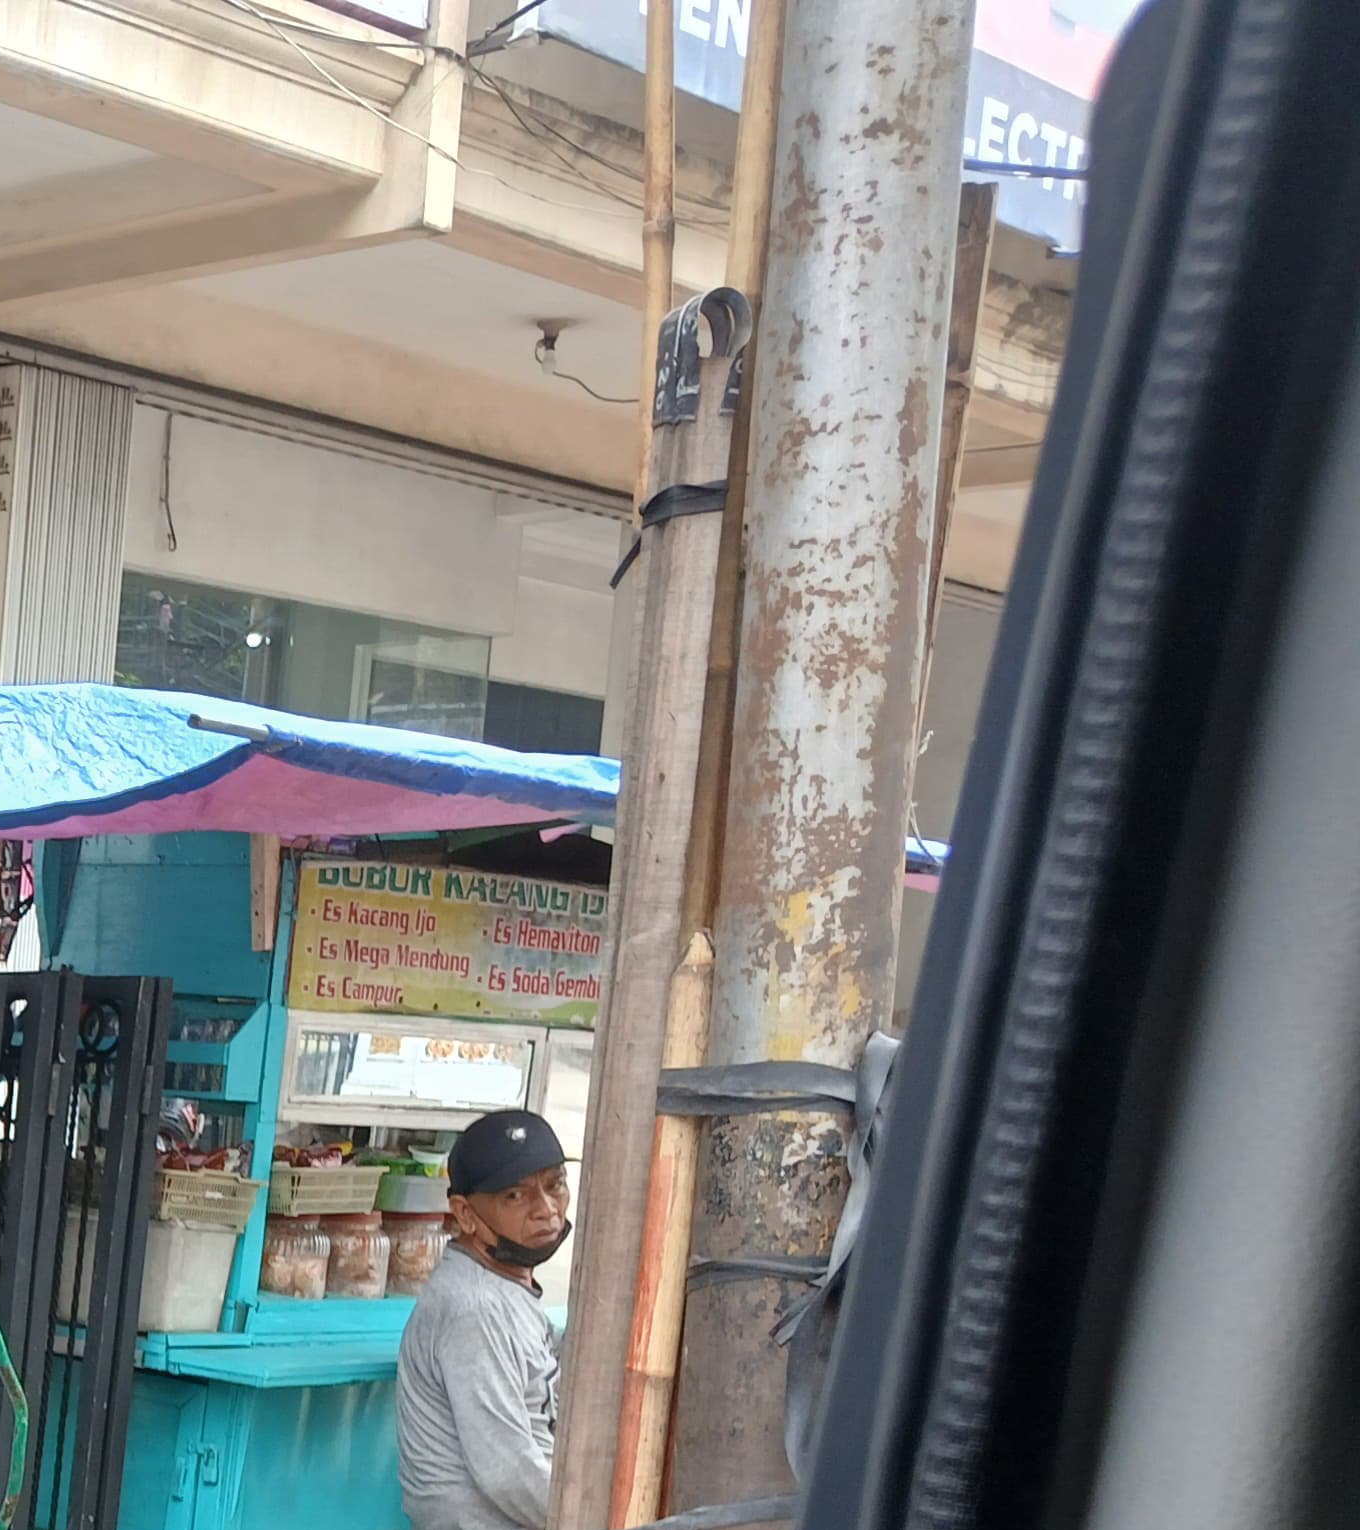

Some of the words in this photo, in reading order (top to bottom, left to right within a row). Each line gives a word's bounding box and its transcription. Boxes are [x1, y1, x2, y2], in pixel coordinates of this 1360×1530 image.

[322, 899, 341, 922] Es
[348, 901, 409, 935] Kacang
[415, 908, 437, 937] Ijo
[493, 917, 512, 944] Es
[517, 919, 601, 955] Hemaviton
[319, 936, 338, 960] Es
[344, 939, 390, 970] Mega
[396, 943, 470, 978] Mendung
[316, 975, 335, 998] Es
[341, 976, 402, 1008] Campur
[488, 964, 507, 991] Es
[511, 967, 550, 995] Soda
